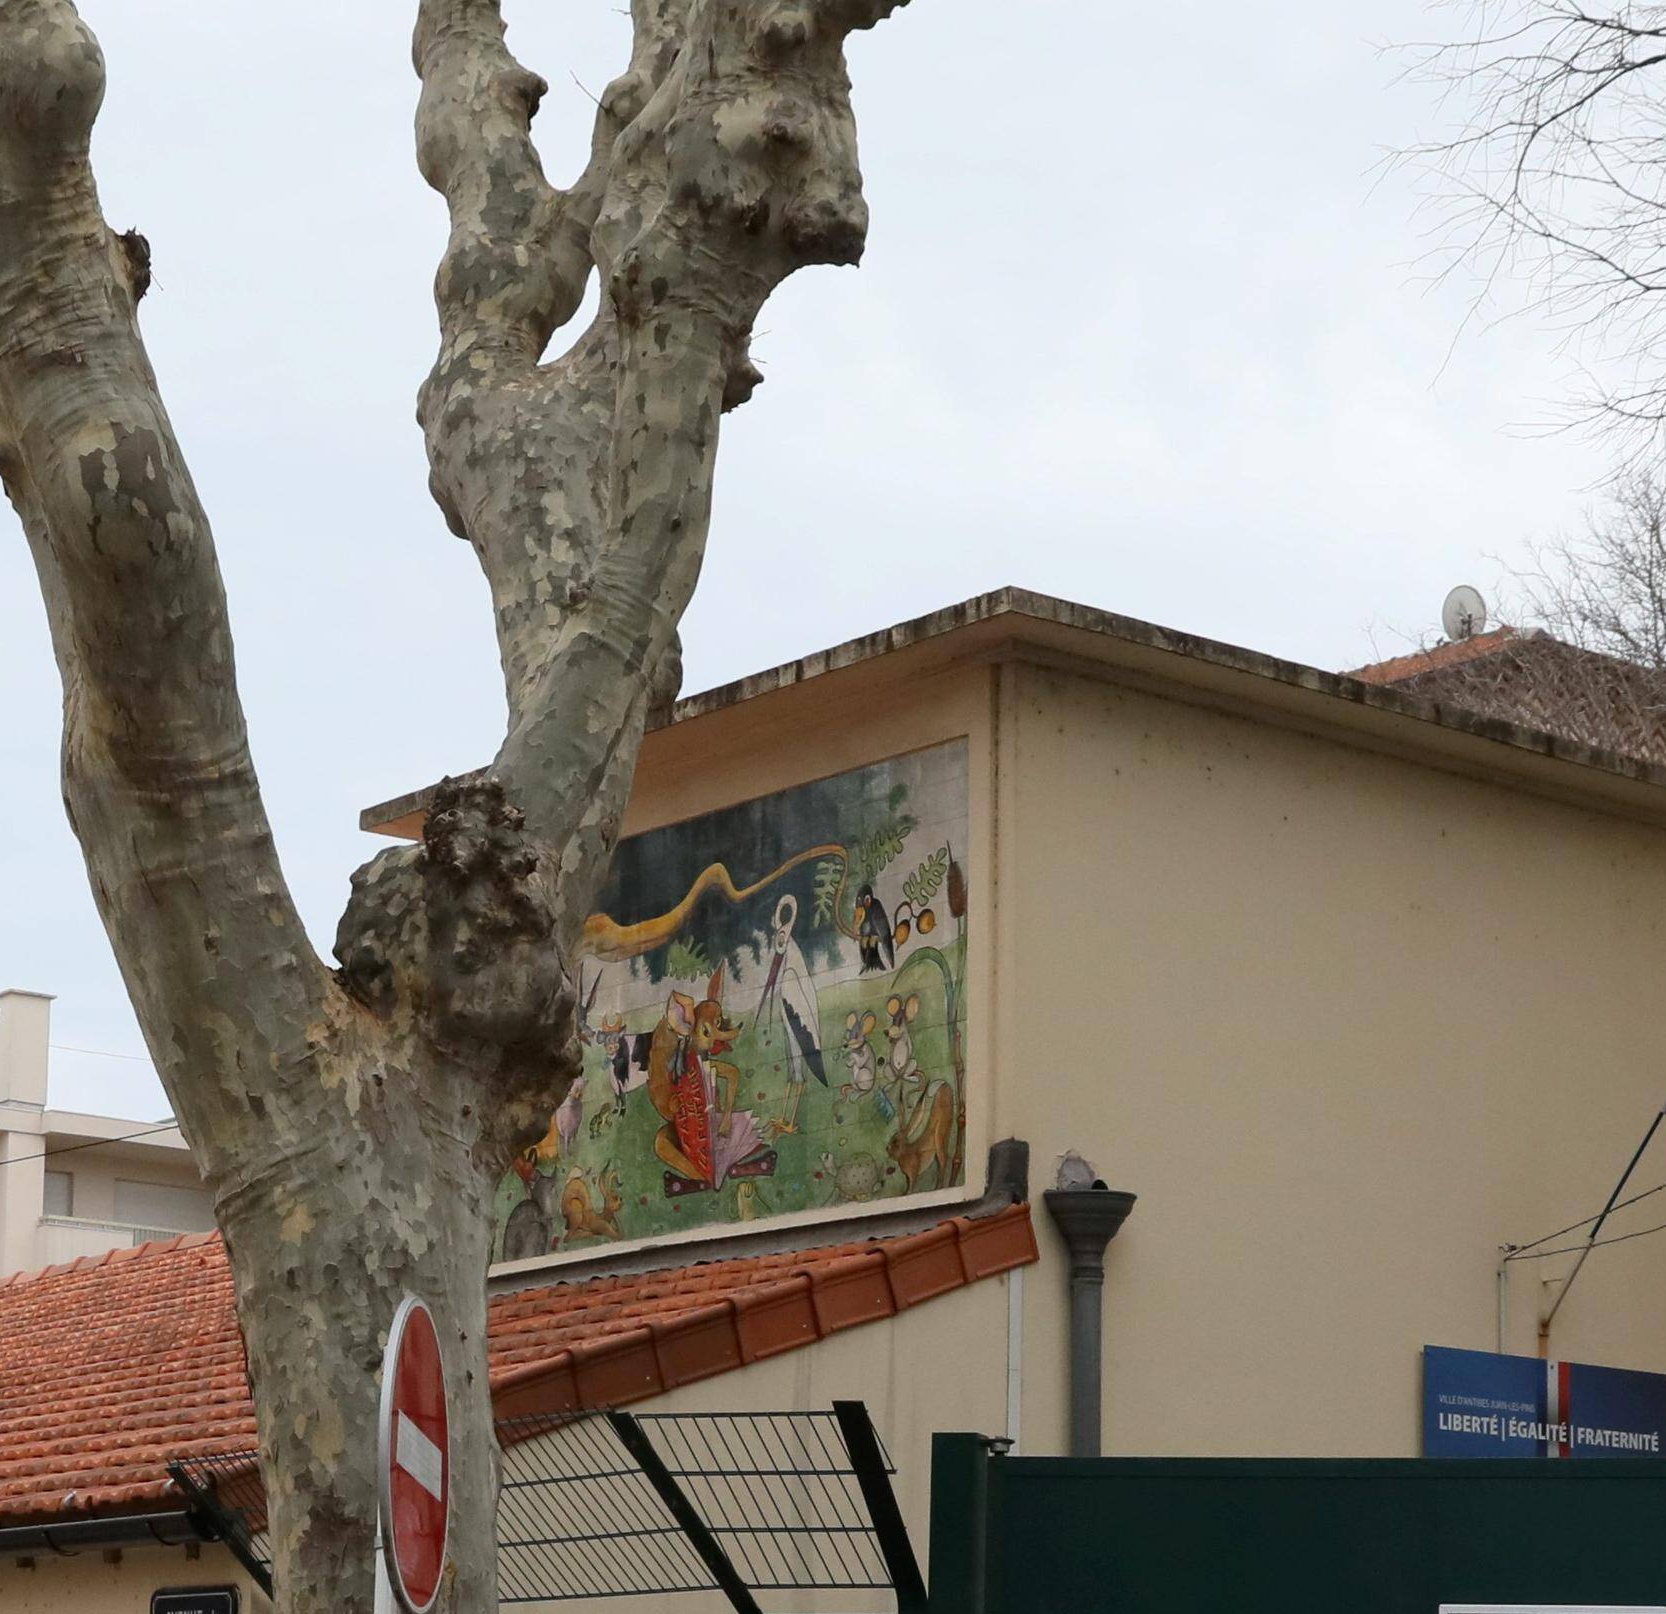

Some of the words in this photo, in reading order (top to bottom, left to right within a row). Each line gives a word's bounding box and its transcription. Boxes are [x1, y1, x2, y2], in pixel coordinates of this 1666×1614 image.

[1439, 1412, 1499, 1436] LIBERTÉ
[1508, 1416, 1568, 1443] ÉGALITÉ
[1576, 1427, 1660, 1452] FRATERNITÉ
